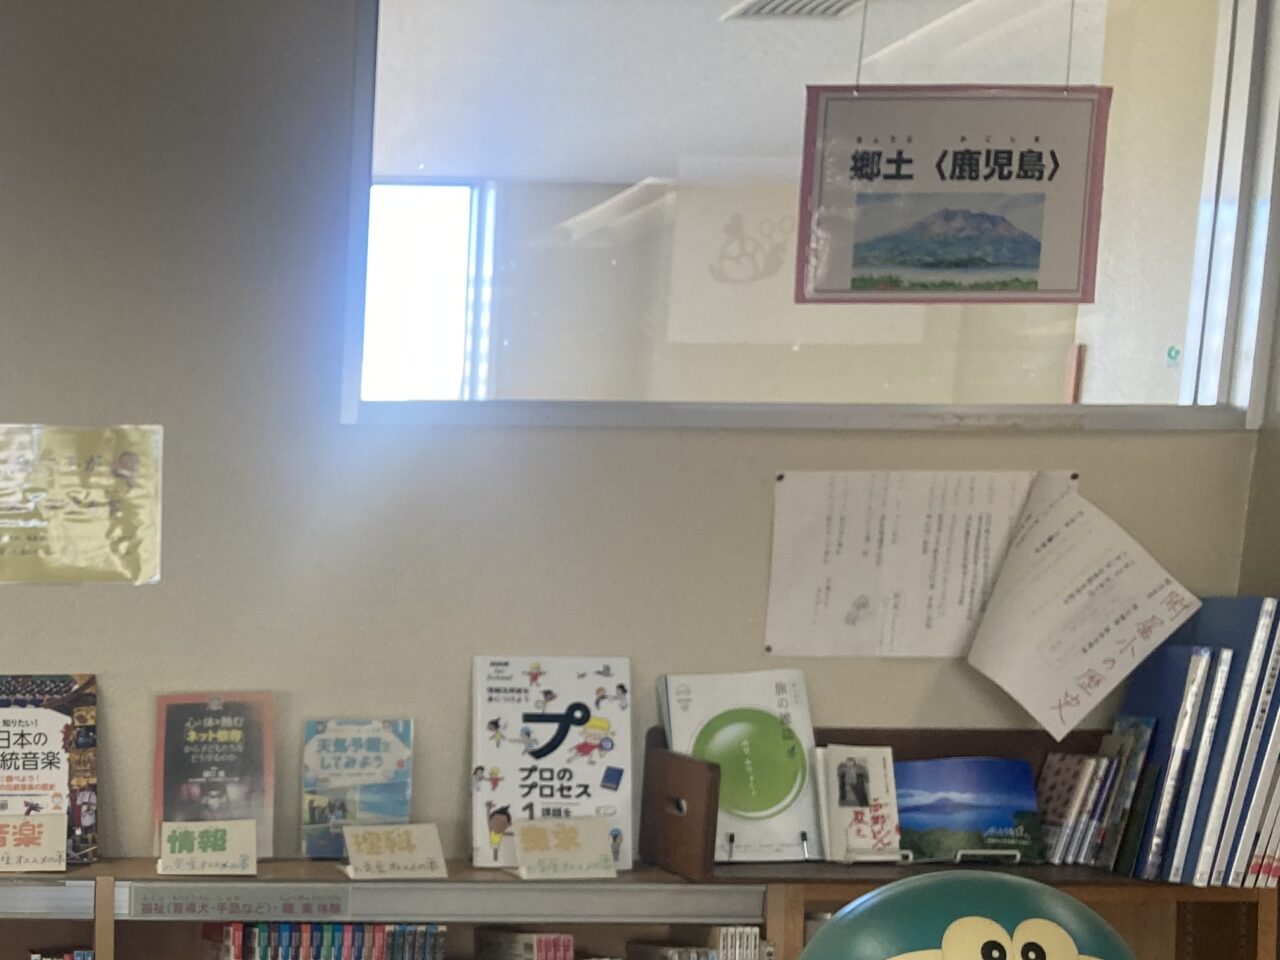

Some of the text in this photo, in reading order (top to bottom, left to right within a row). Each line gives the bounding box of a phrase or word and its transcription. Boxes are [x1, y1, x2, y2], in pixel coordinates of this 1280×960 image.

[850, 149, 1060, 181] 郷土 〈鹿児島〉
[522, 701, 591, 759] プ
[519, 766, 573, 781] プロの
[519, 783, 591, 798] プロセス
[522, 803, 535, 820] 1
